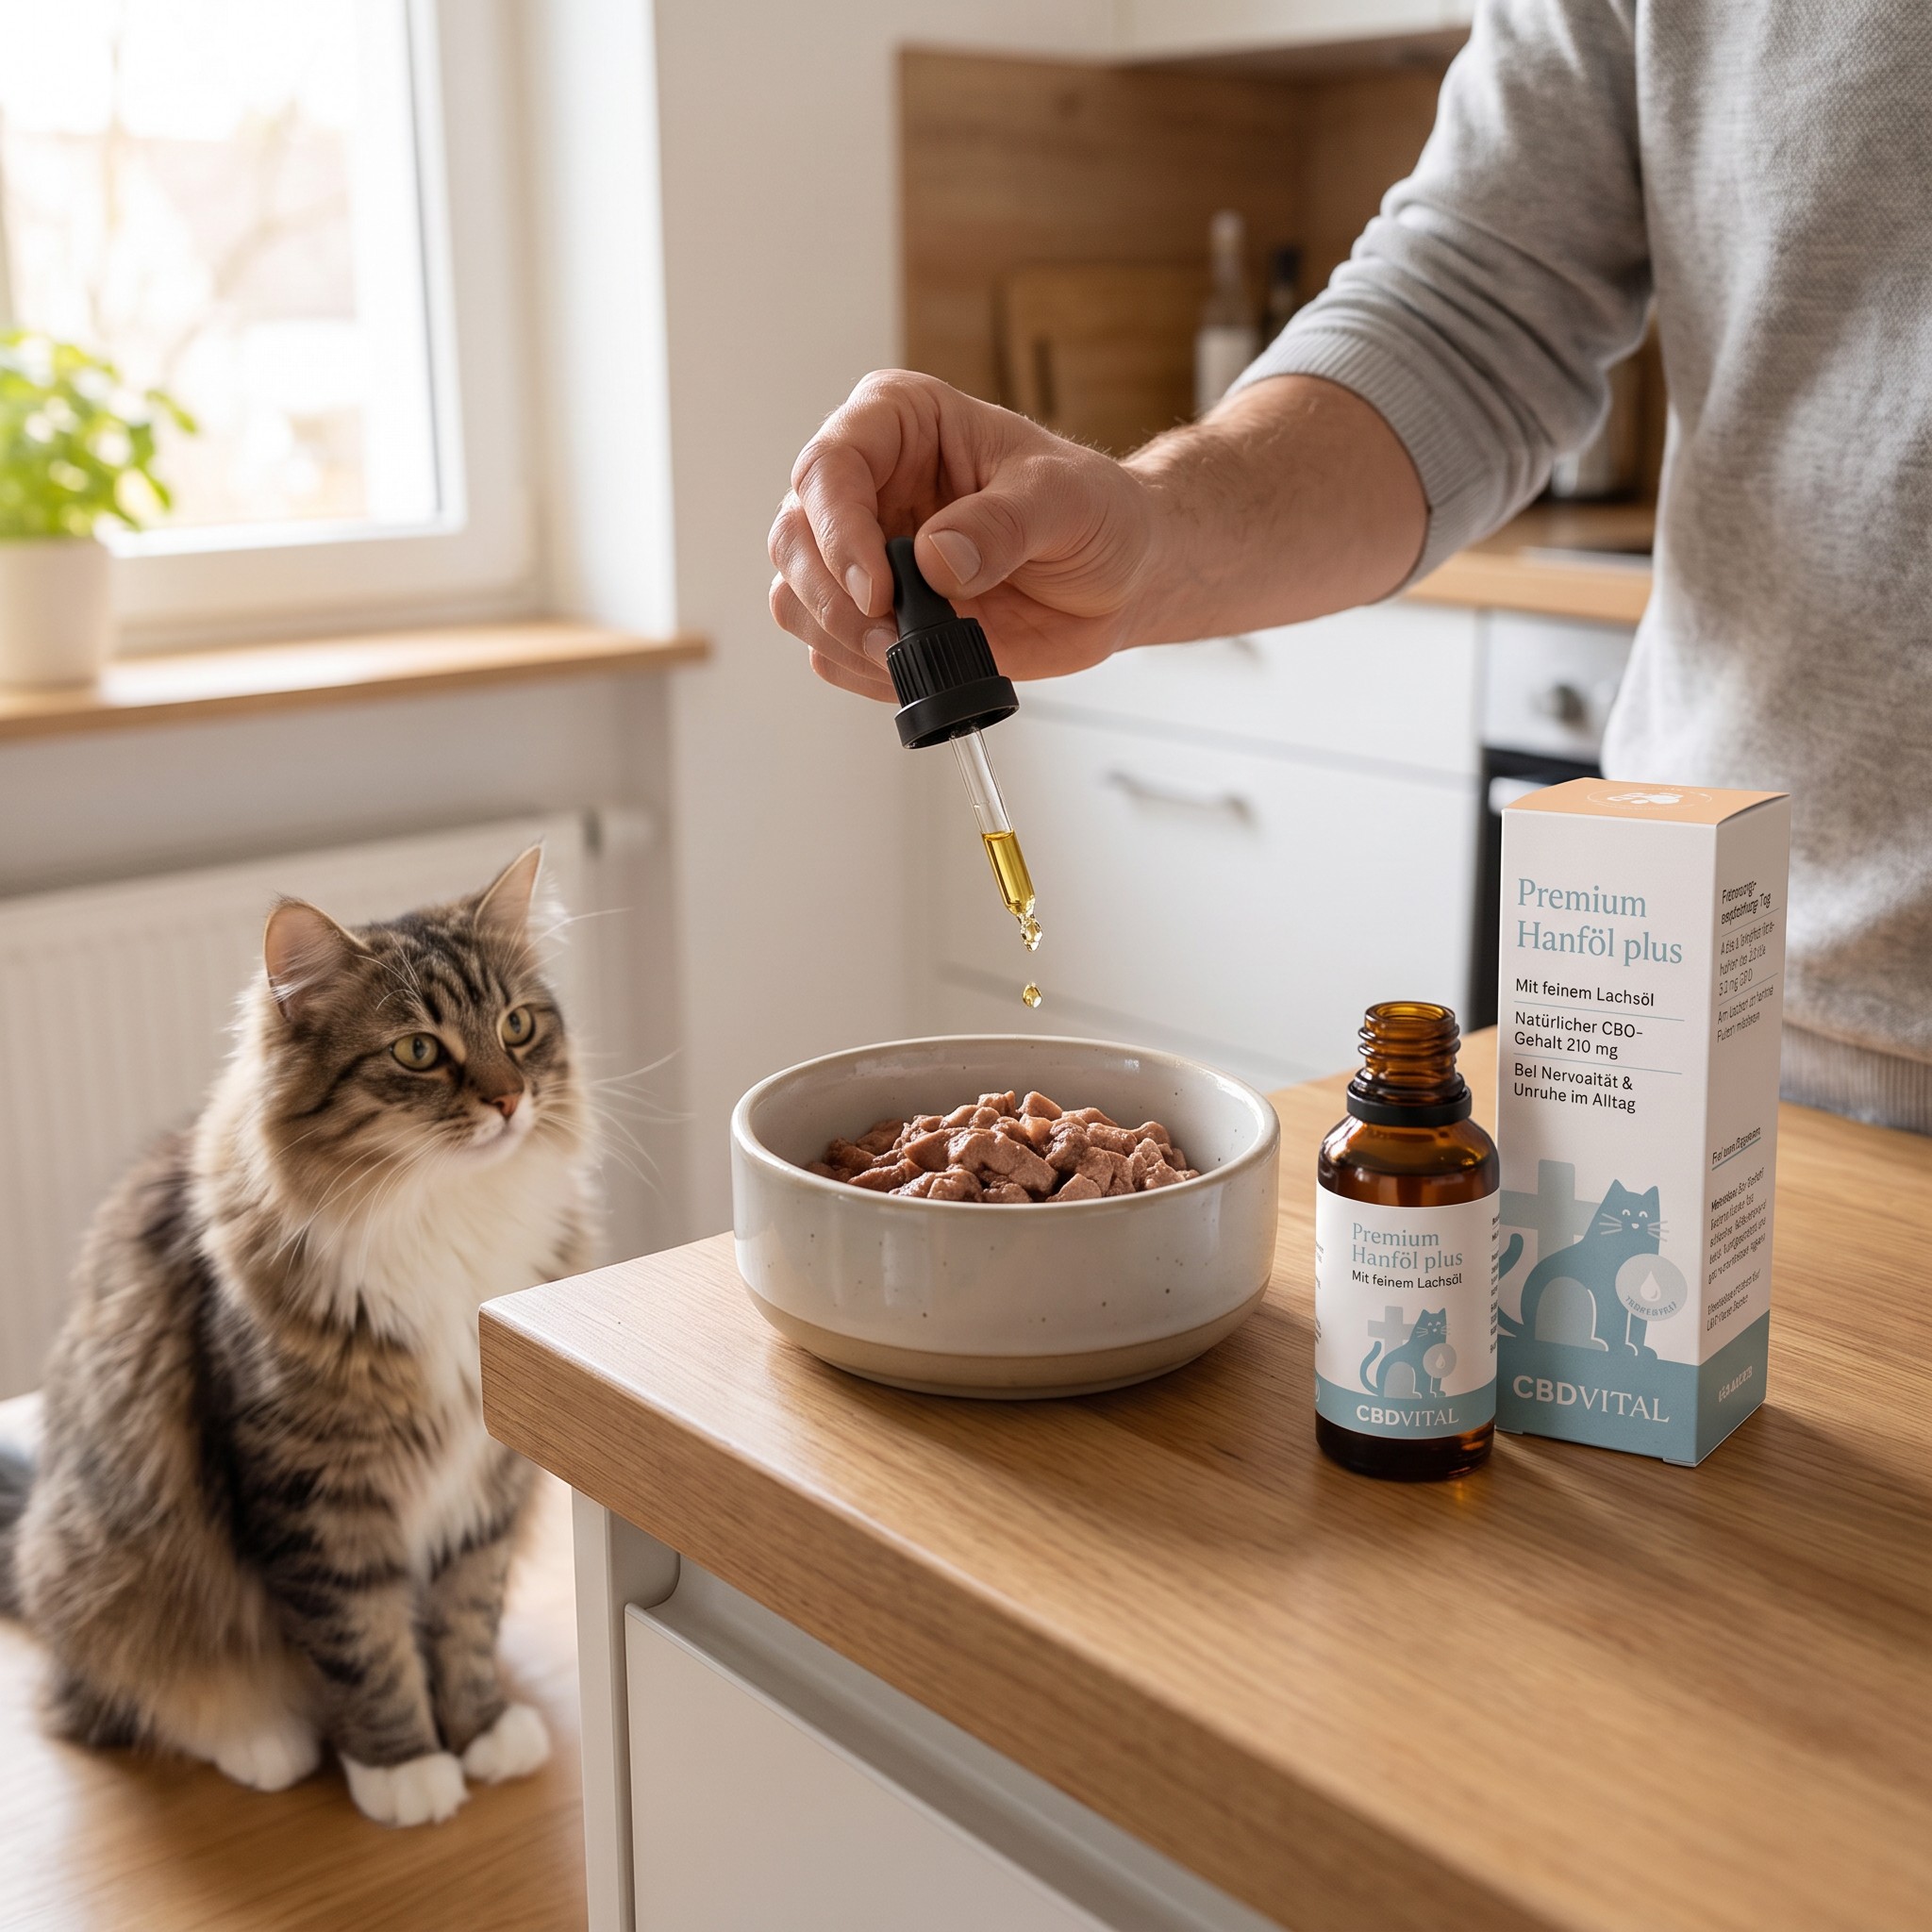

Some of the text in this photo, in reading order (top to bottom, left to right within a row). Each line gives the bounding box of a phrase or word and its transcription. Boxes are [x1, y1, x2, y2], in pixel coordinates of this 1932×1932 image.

[1517, 878, 1647, 918] Premium
[1517, 920, 1614, 958] Hanföl
[1623, 932, 1683, 967] plus
[1516, 977, 1654, 1007] Mit feinem Lachsöl
[1515, 1011, 1598, 1034] Natürlicher
[1514, 1031, 1618, 1060] Gehalt 210 mg
[1622, 1075, 1633, 1091] &
[1514, 1082, 1636, 1114] Unruhe im Alltag
[1353, 1223, 1440, 1247] Premium
[1352, 1244, 1419, 1270] Hanföl
[1424, 1250, 1463, 1274] plus
[1352, 1270, 1370, 1284] Mit
[1373, 1274, 1413, 1289] feinem
[1512, 1374, 1670, 1424] CBDVITAL
[1356, 1405, 1459, 1427] CBDVITAL
